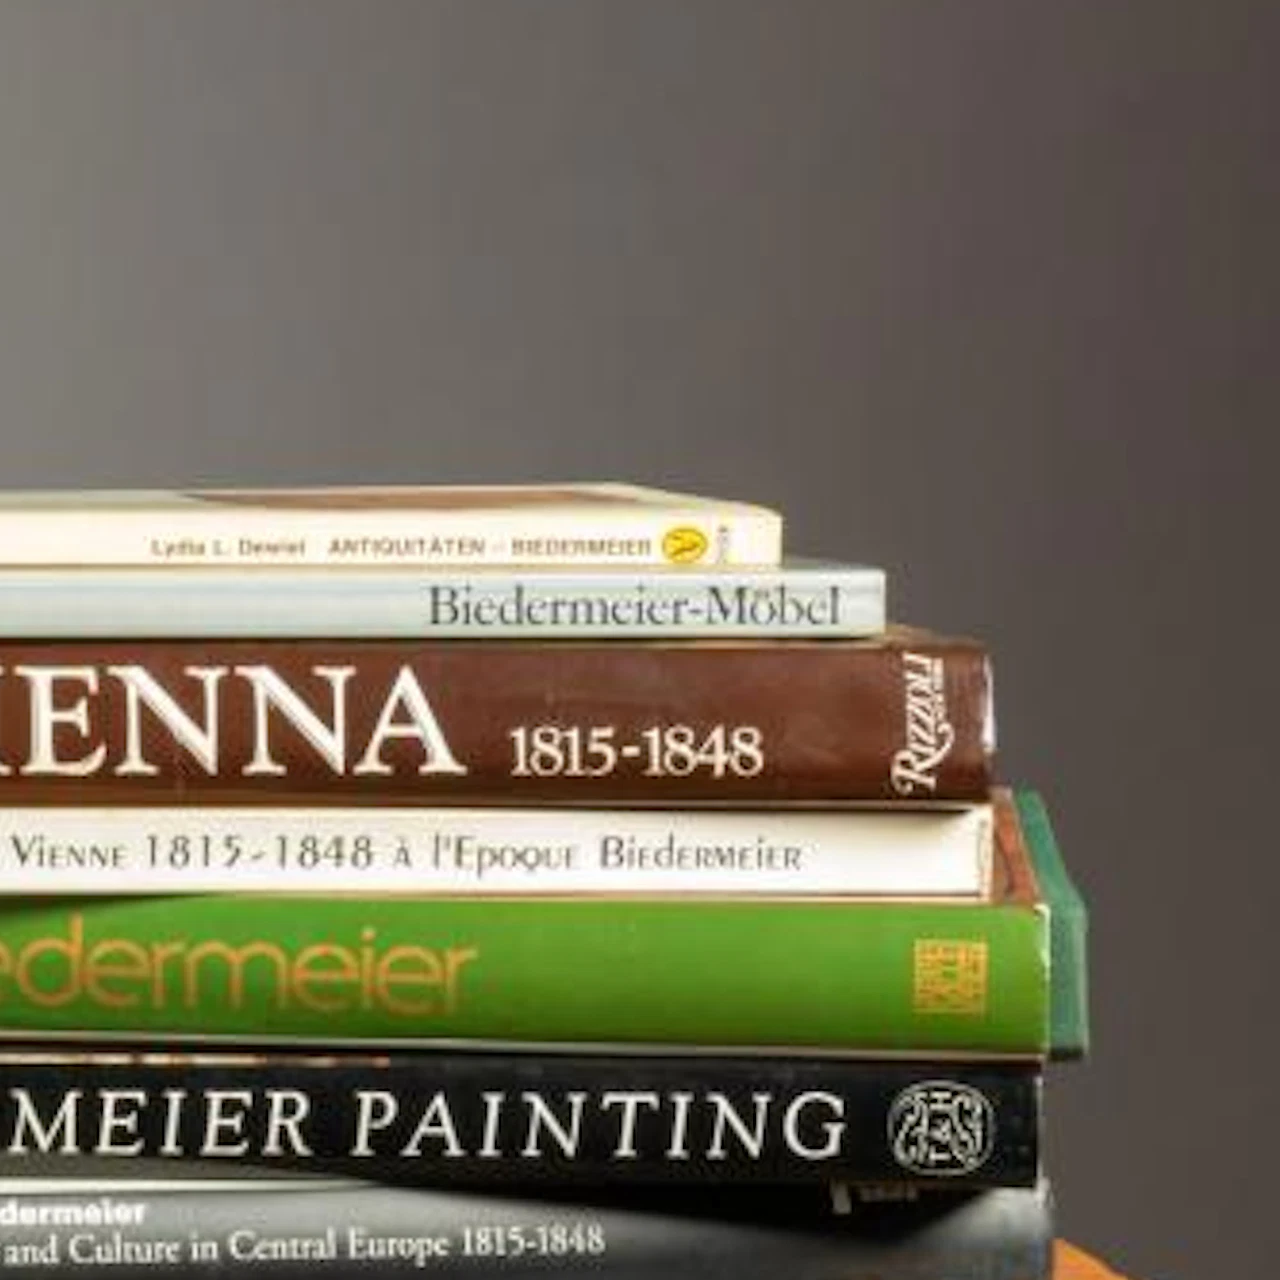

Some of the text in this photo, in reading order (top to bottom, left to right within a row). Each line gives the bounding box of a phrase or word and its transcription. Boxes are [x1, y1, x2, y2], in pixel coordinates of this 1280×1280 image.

[510, 538, 652, 557] BIEDERMEIER
[428, 583, 840, 627] Biedermeier-Möbel
[509, 724, 765, 777] 1815-1848
[350, 1089, 847, 1161] PAINTING
[5, 1232, 60, 1265] and
[67, 1230, 181, 1264] Culture
[190, 1230, 219, 1261] in
[227, 1224, 337, 1260] Central
[346, 1224, 450, 1267] Europe
[462, 1223, 606, 1256] 1815-1848
